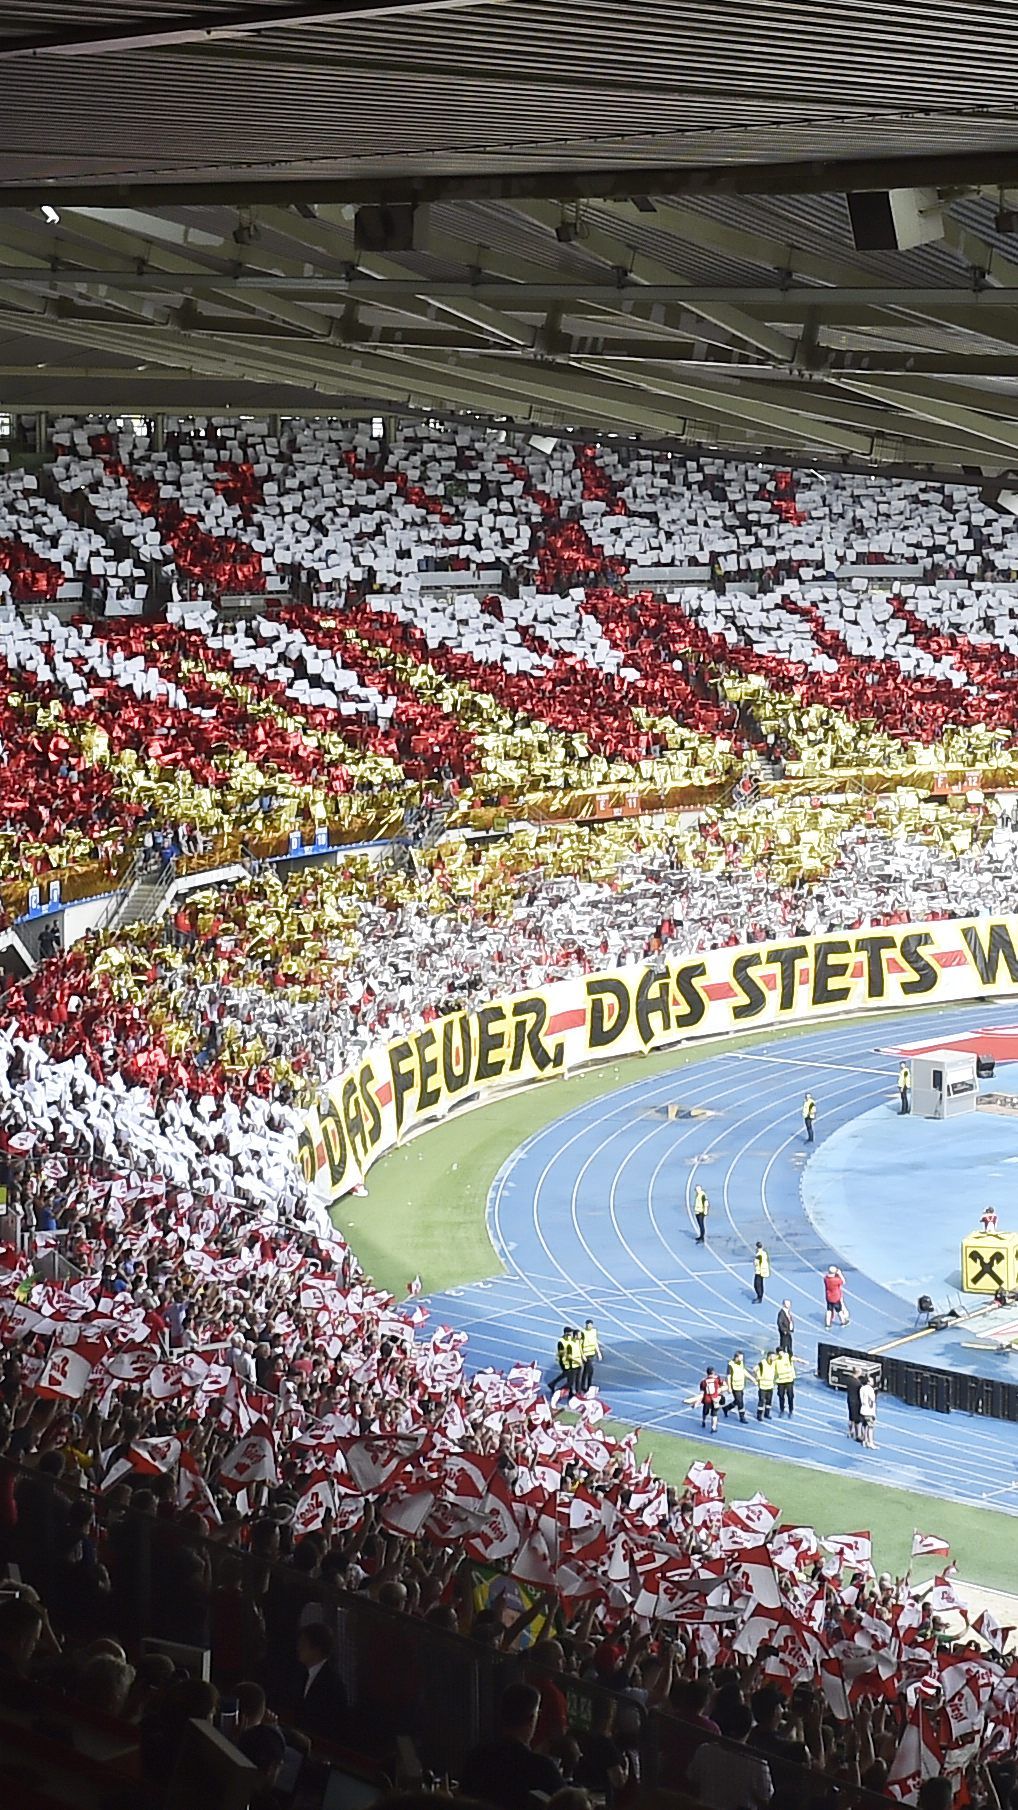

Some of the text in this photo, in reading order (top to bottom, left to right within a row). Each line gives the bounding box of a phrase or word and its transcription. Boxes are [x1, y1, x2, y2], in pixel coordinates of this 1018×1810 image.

[318, 1065, 382, 1187] DAS
[389, 998, 565, 1129] FEUER,
[586, 962, 707, 1047] DAS
[732, 932, 938, 1020] STETS
